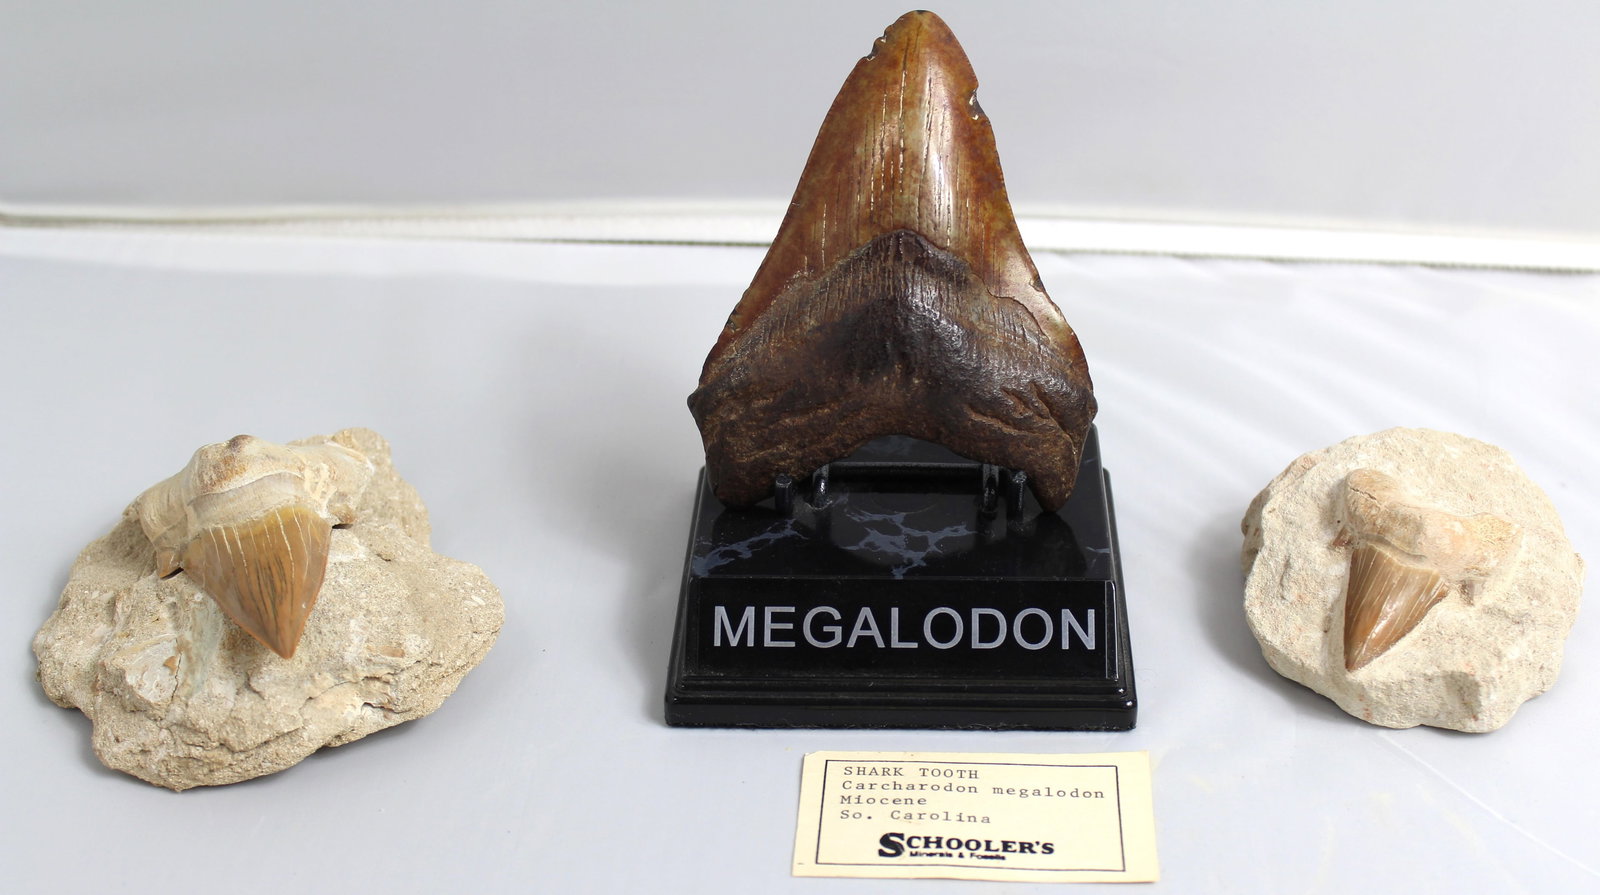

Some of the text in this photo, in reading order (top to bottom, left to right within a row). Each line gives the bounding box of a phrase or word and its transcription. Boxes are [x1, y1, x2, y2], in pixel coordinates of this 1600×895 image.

[713, 606, 1097, 651] MEGALODON
[843, 766, 980, 779] SHARK TOOTH
[842, 780, 1105, 799] Carcharodon megalodon
[840, 795, 927, 805] Miocene
[840, 810, 991, 824] So. Carolina
[878, 832, 1055, 858] SCHOOLER'S
